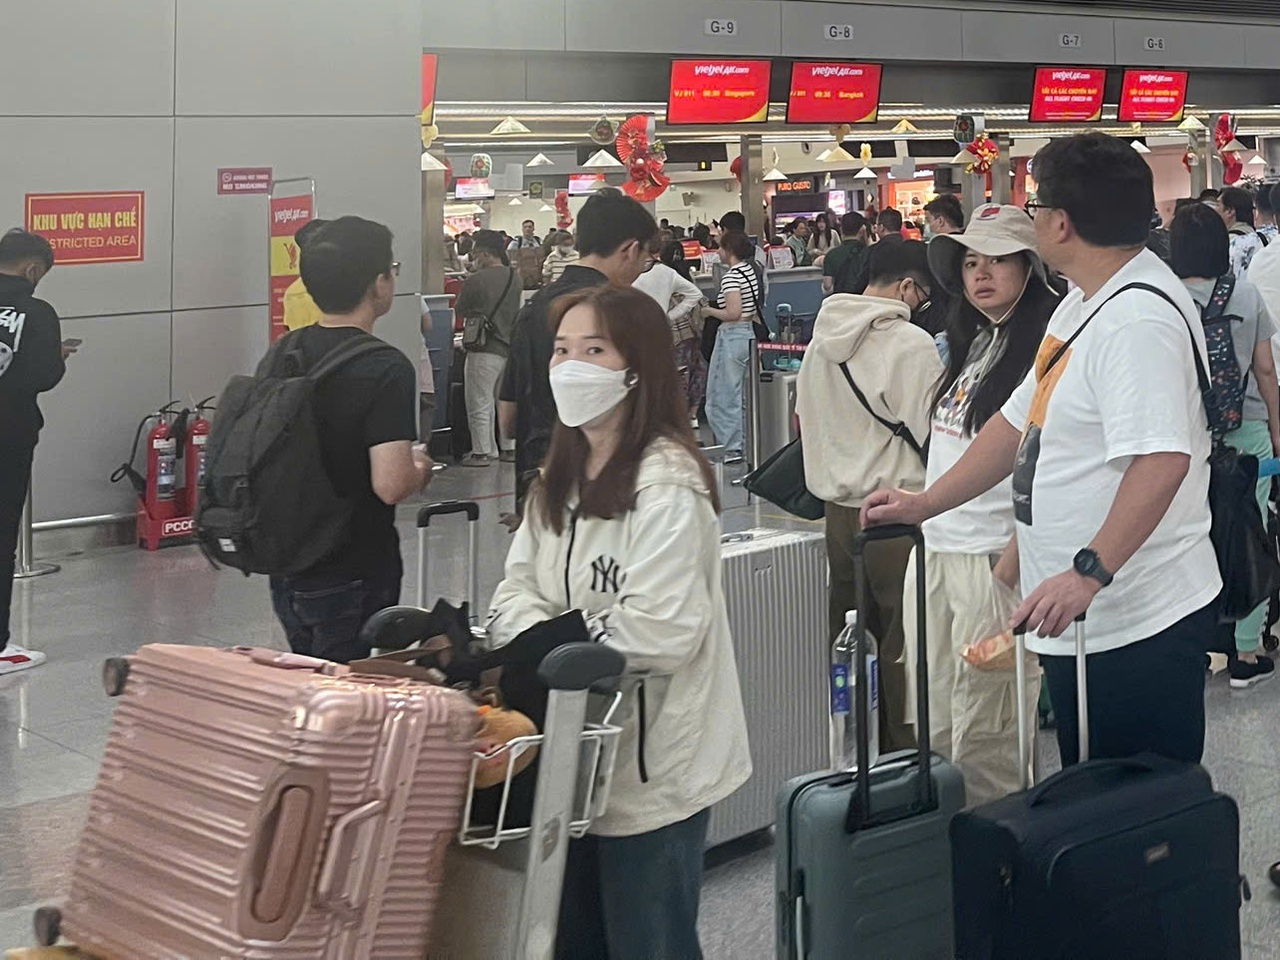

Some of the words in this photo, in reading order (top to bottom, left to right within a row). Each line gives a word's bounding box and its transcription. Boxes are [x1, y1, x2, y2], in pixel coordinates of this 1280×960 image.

[710, 20, 734, 34] G-9
[829, 25, 850, 38] G-8
[1062, 34, 1079, 46] G-7
[1147, 38, 1163, 49] G-6
[33, 214, 58, 231] KHU
[88, 212, 111, 231] HẠN
[114, 206, 137, 228] CHẾ
[46, 236, 104, 250] STRICTED
[106, 234, 137, 246] AREA
[590, 554, 620, 594] NY
